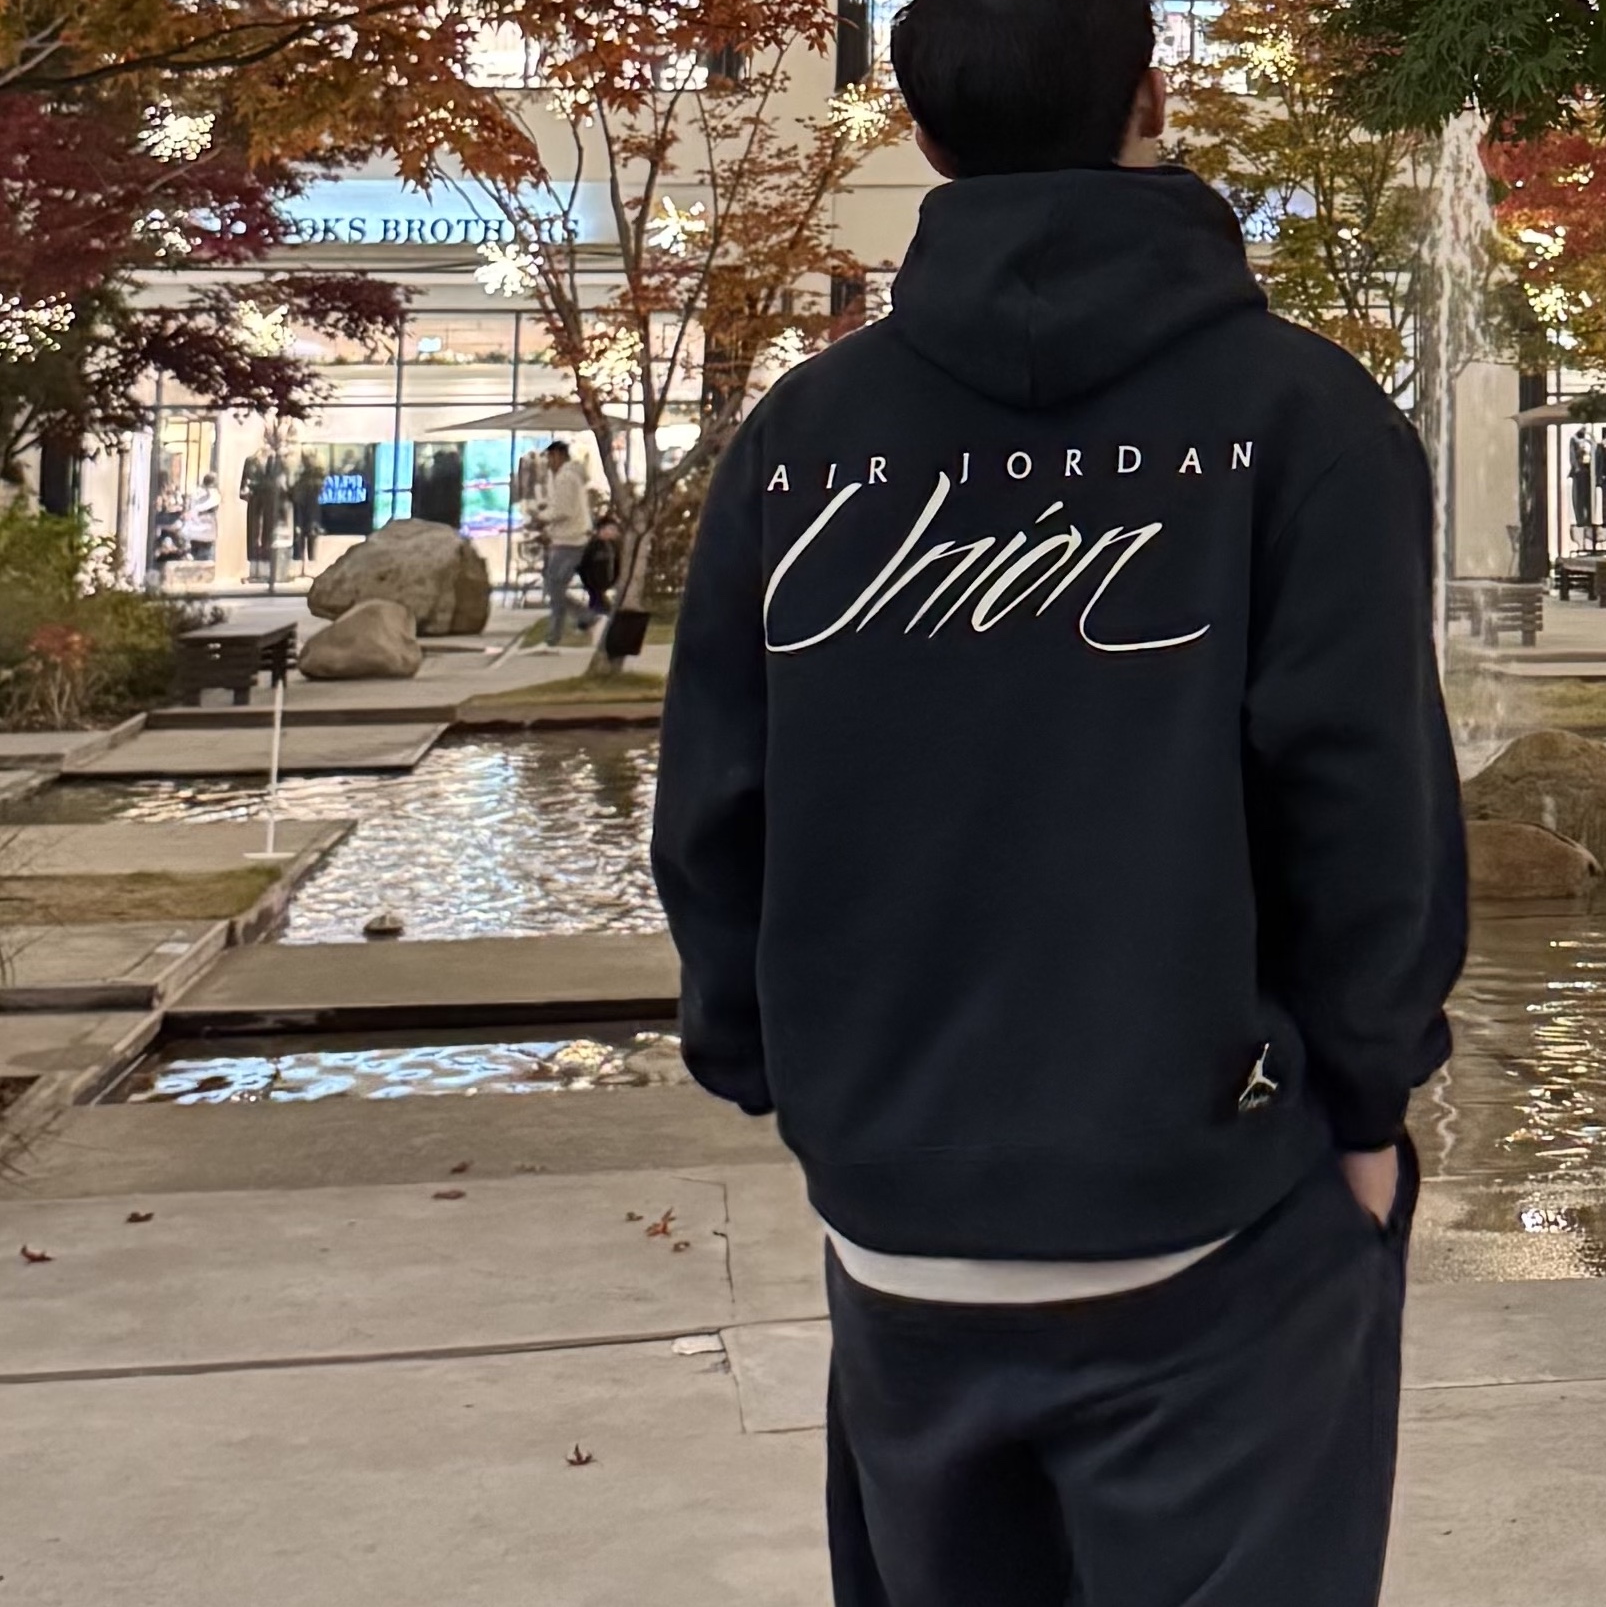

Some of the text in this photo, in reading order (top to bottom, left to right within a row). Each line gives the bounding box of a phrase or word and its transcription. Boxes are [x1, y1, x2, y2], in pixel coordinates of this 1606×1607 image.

[379, 217, 580, 244] BROTHRS
[766, 441, 1254, 492] AIR JORDAN
